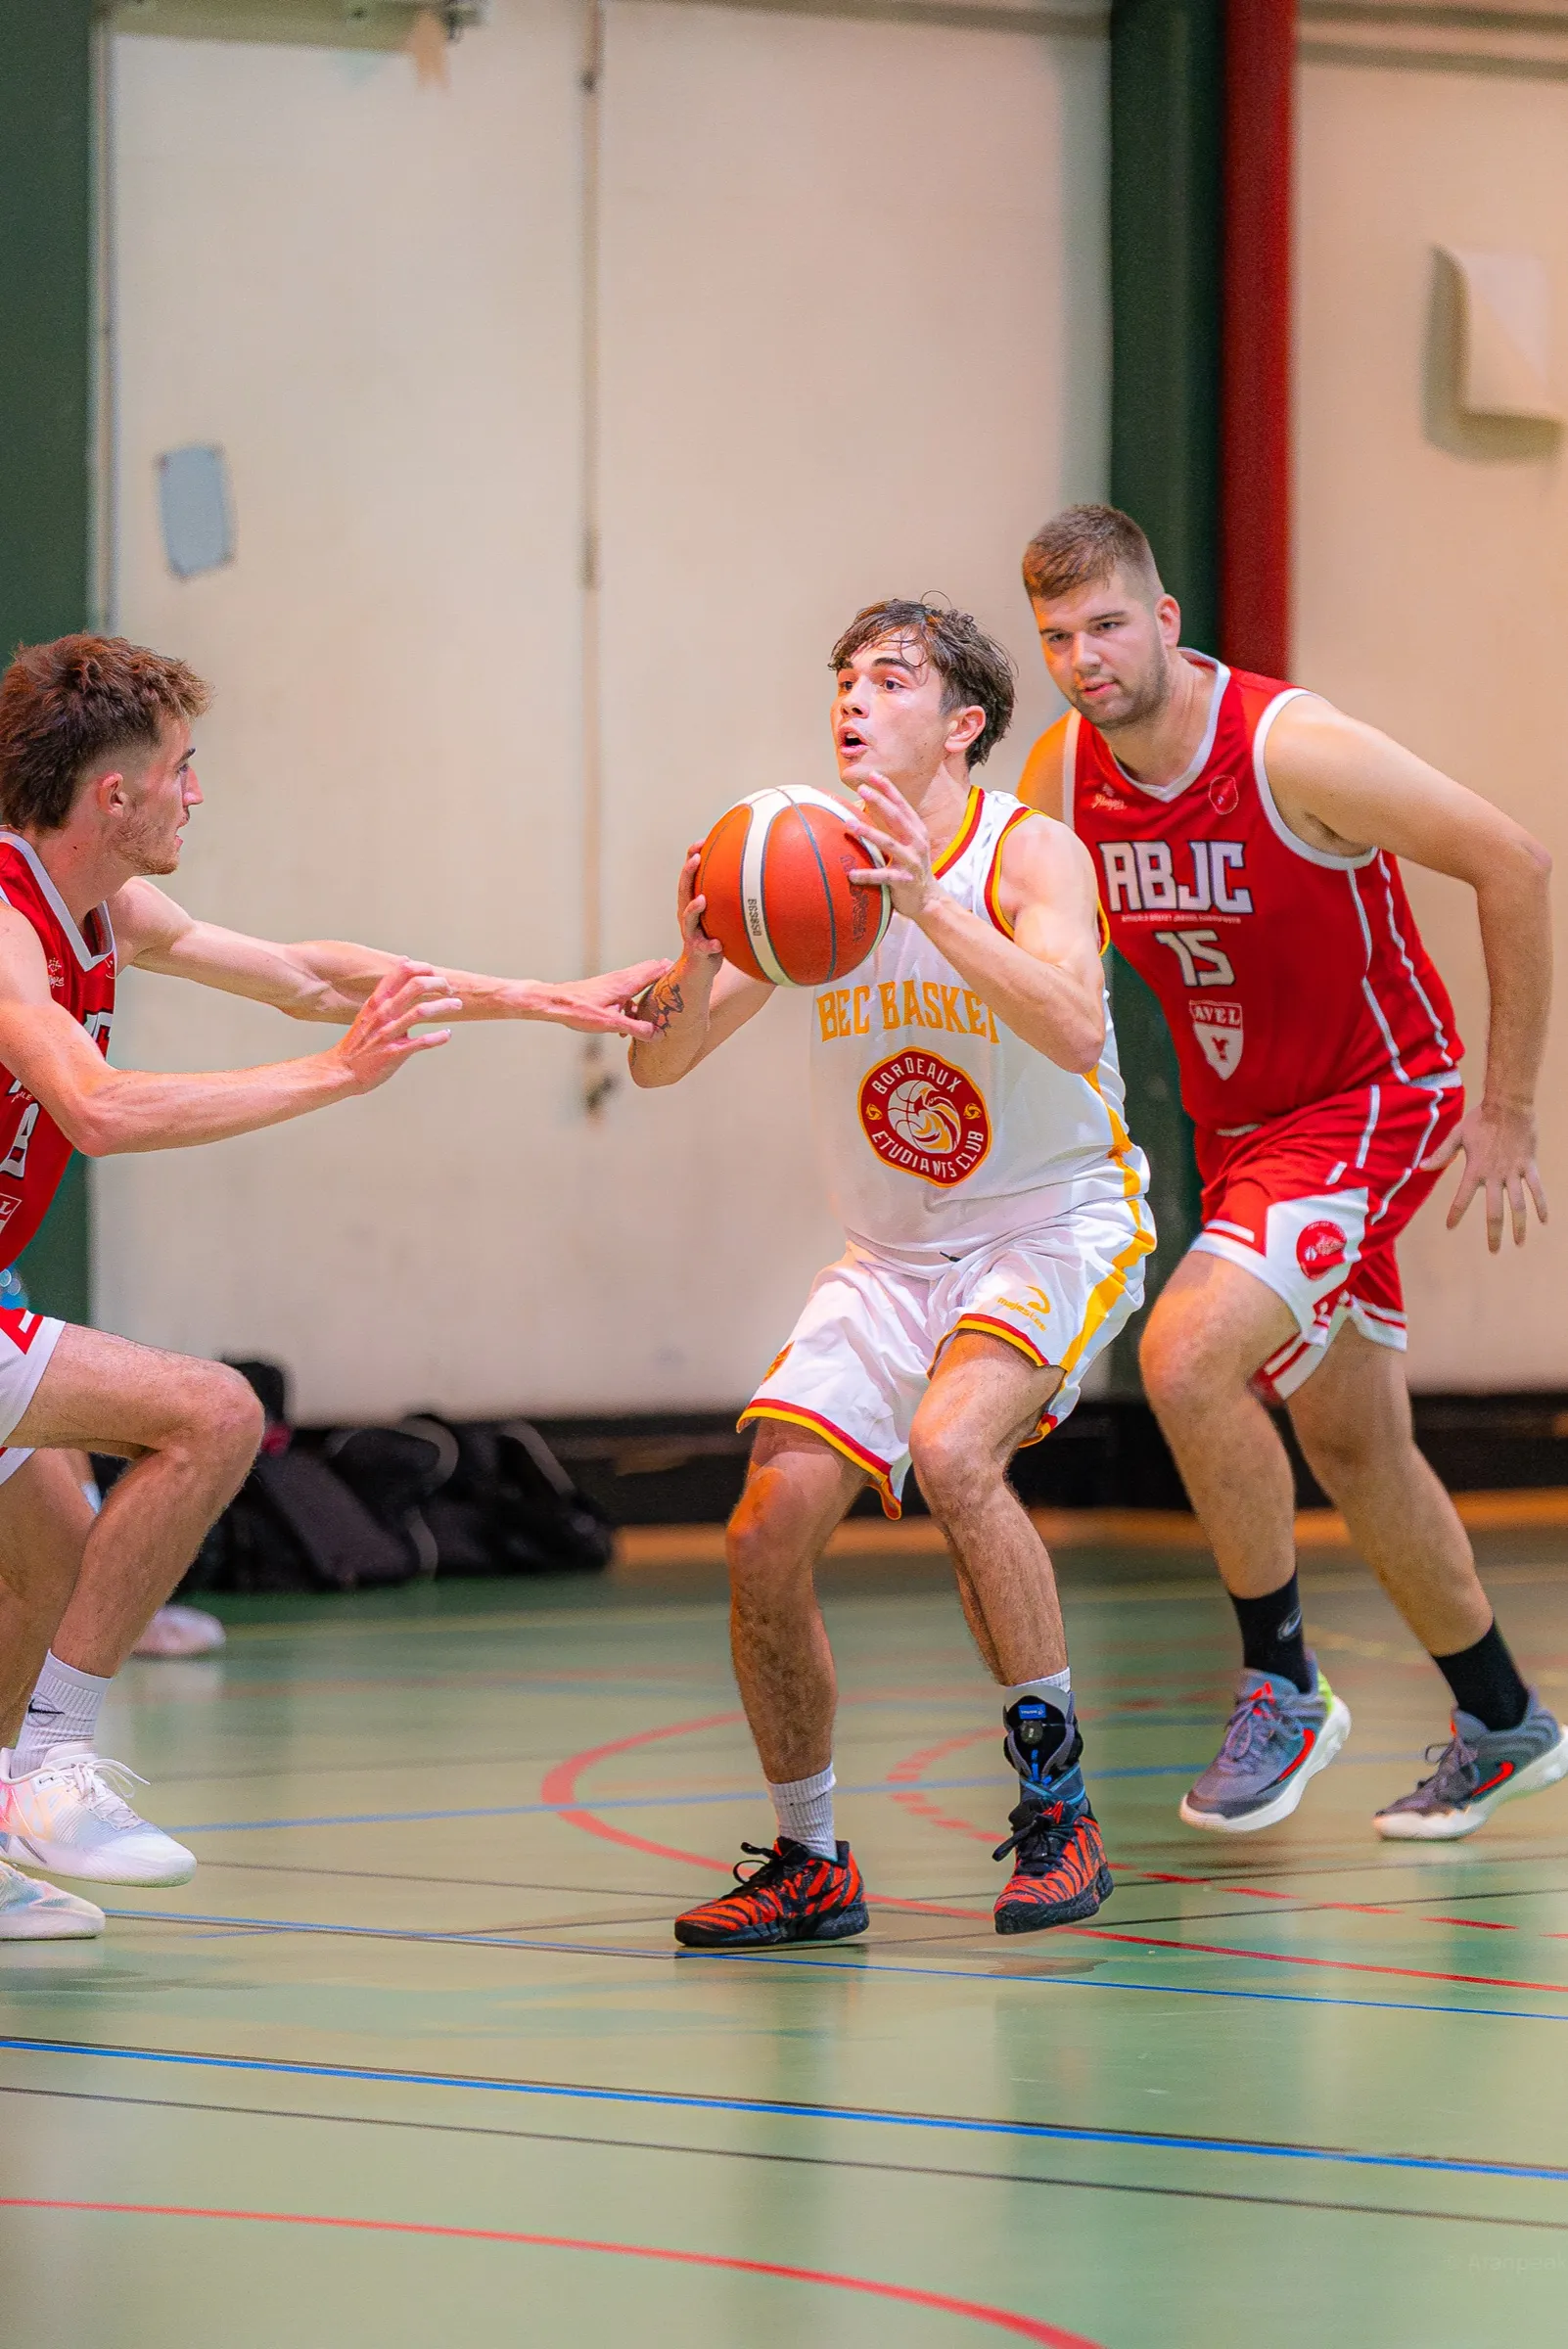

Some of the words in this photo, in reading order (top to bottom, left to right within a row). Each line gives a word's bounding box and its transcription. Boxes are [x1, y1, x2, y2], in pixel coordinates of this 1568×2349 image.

[1098, 841, 1254, 913] ABJC
[1154, 929, 1235, 987] 15
[815, 984, 871, 1042] BEC
[871, 1057, 963, 1094] BORDEAUX
[871, 1129, 958, 1178] ETUDIANTS
[955, 1130, 985, 1171] CLUB
